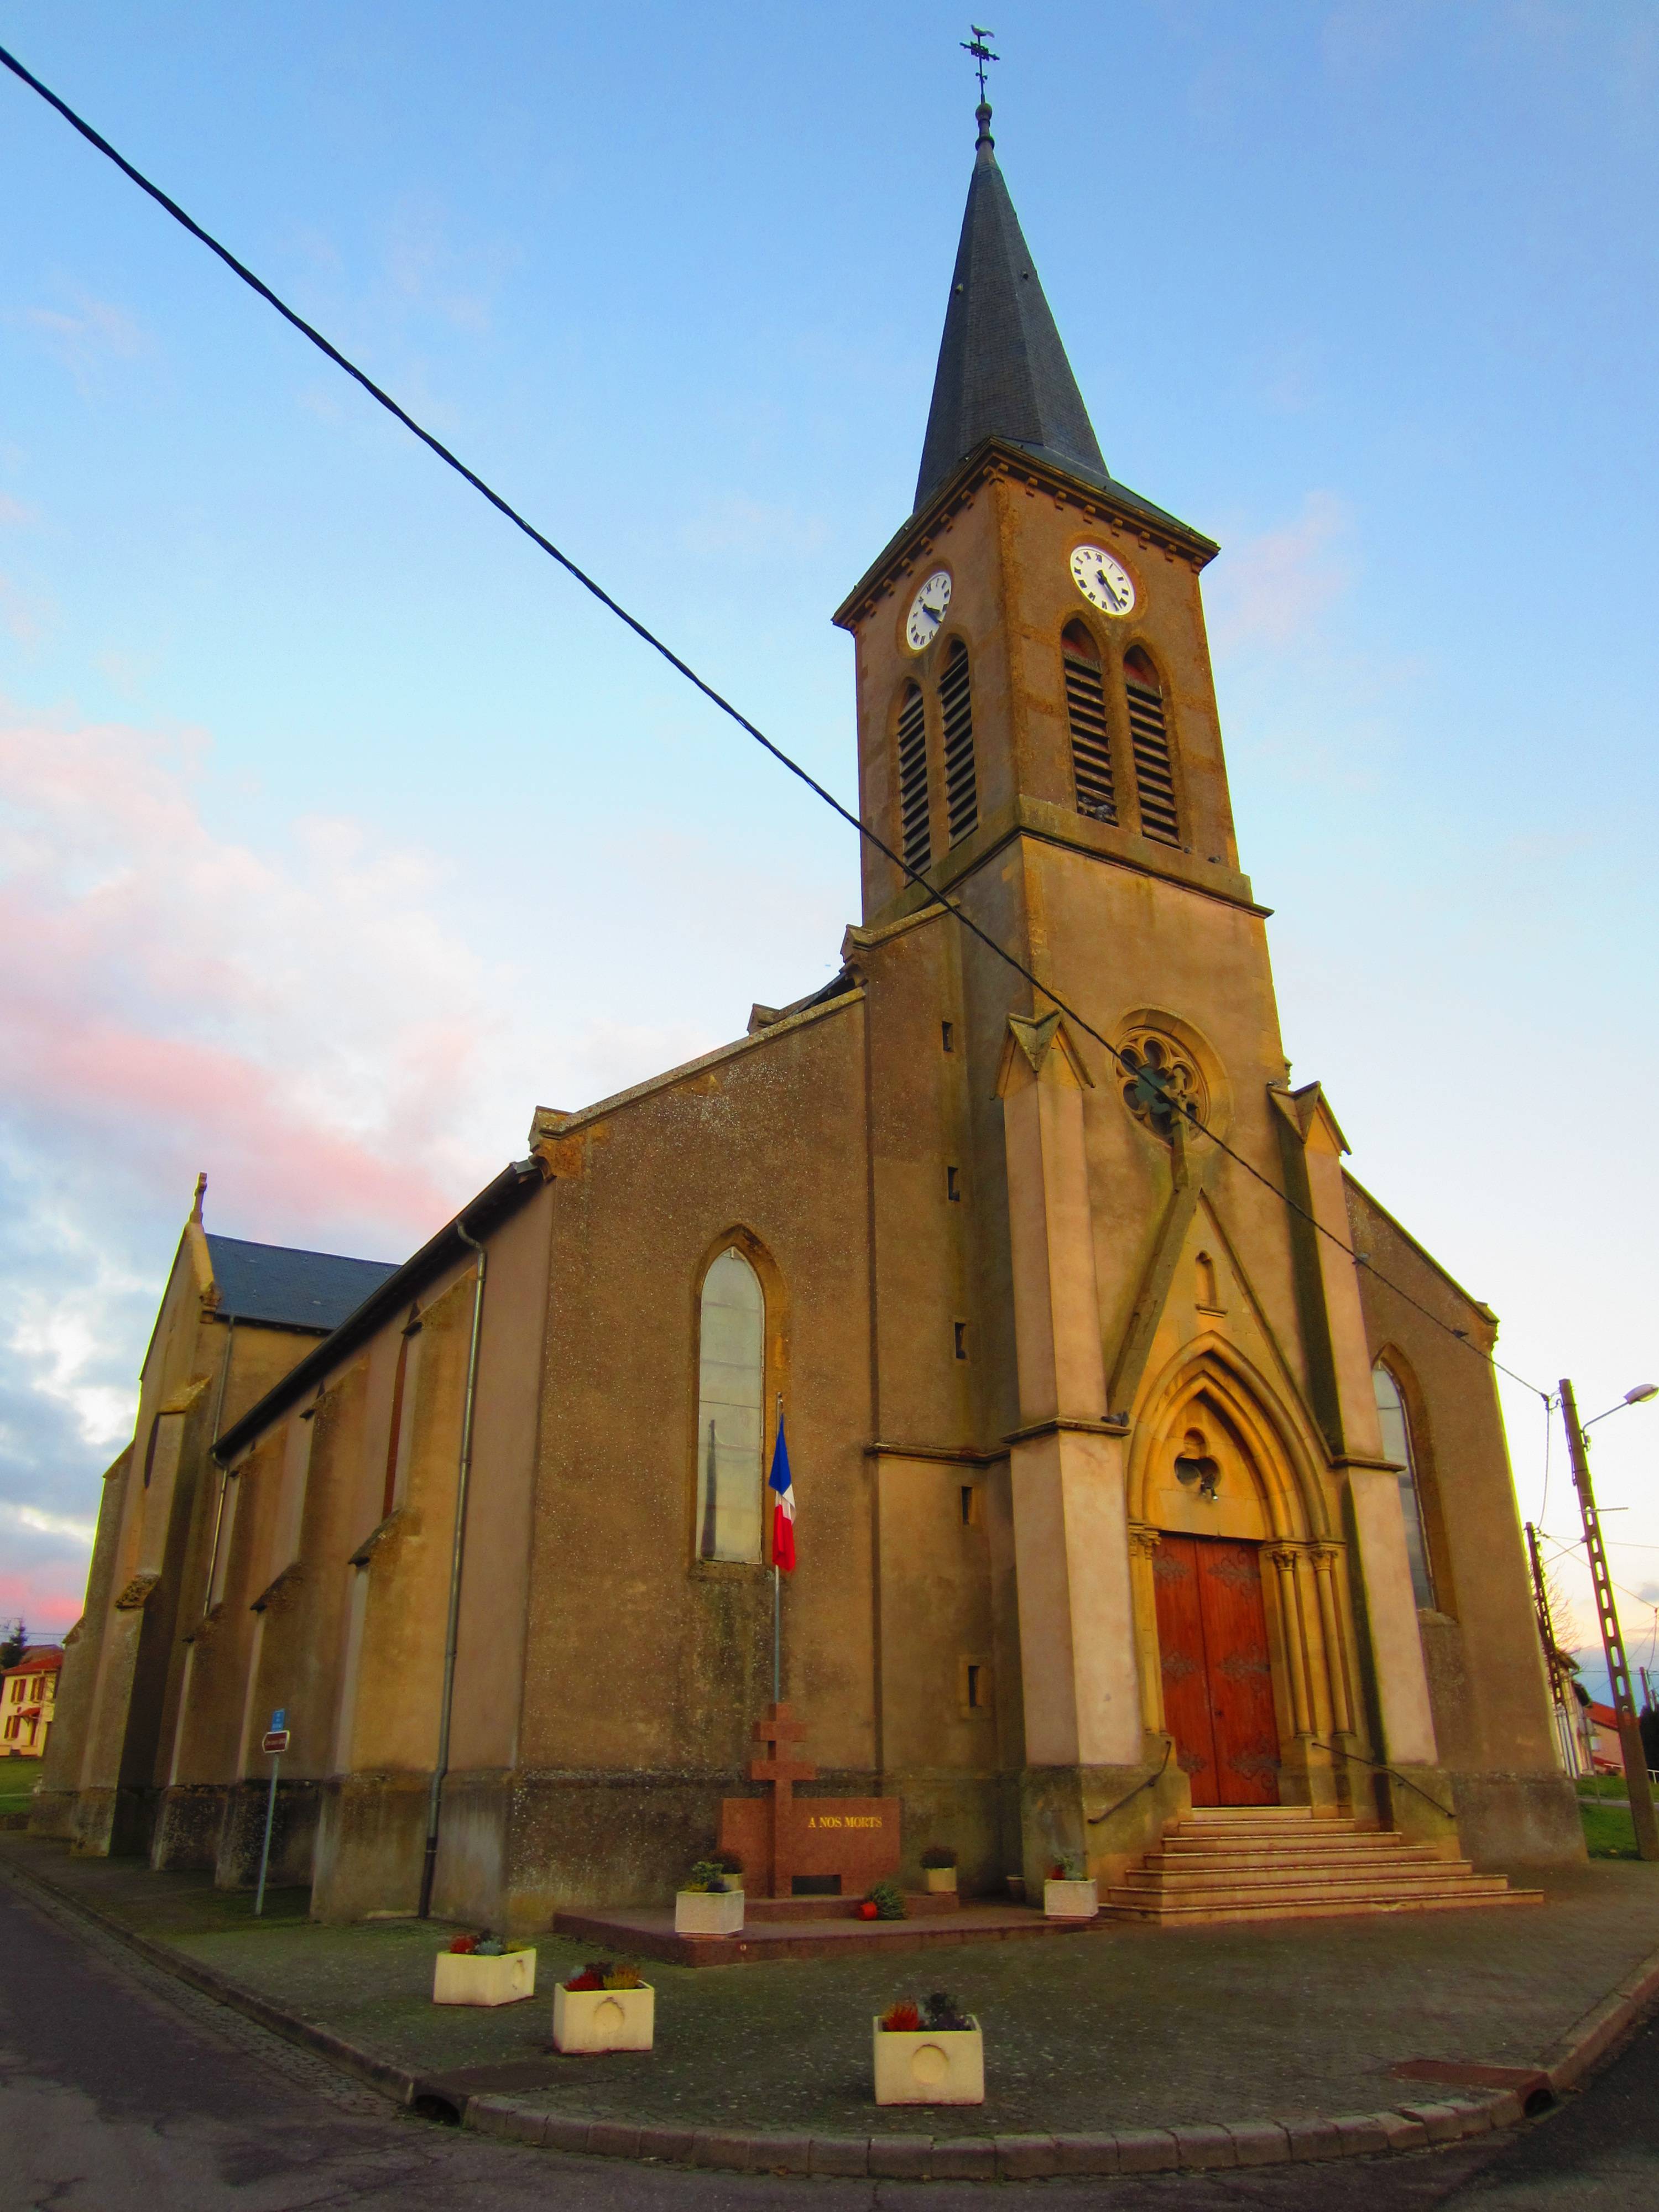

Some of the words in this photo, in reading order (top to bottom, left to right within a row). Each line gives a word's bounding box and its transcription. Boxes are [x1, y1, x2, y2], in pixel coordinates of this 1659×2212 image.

[808, 1817, 816, 1827] A
[819, 1816, 842, 1827] NOS
[844, 1817, 883, 1827] MORTS
